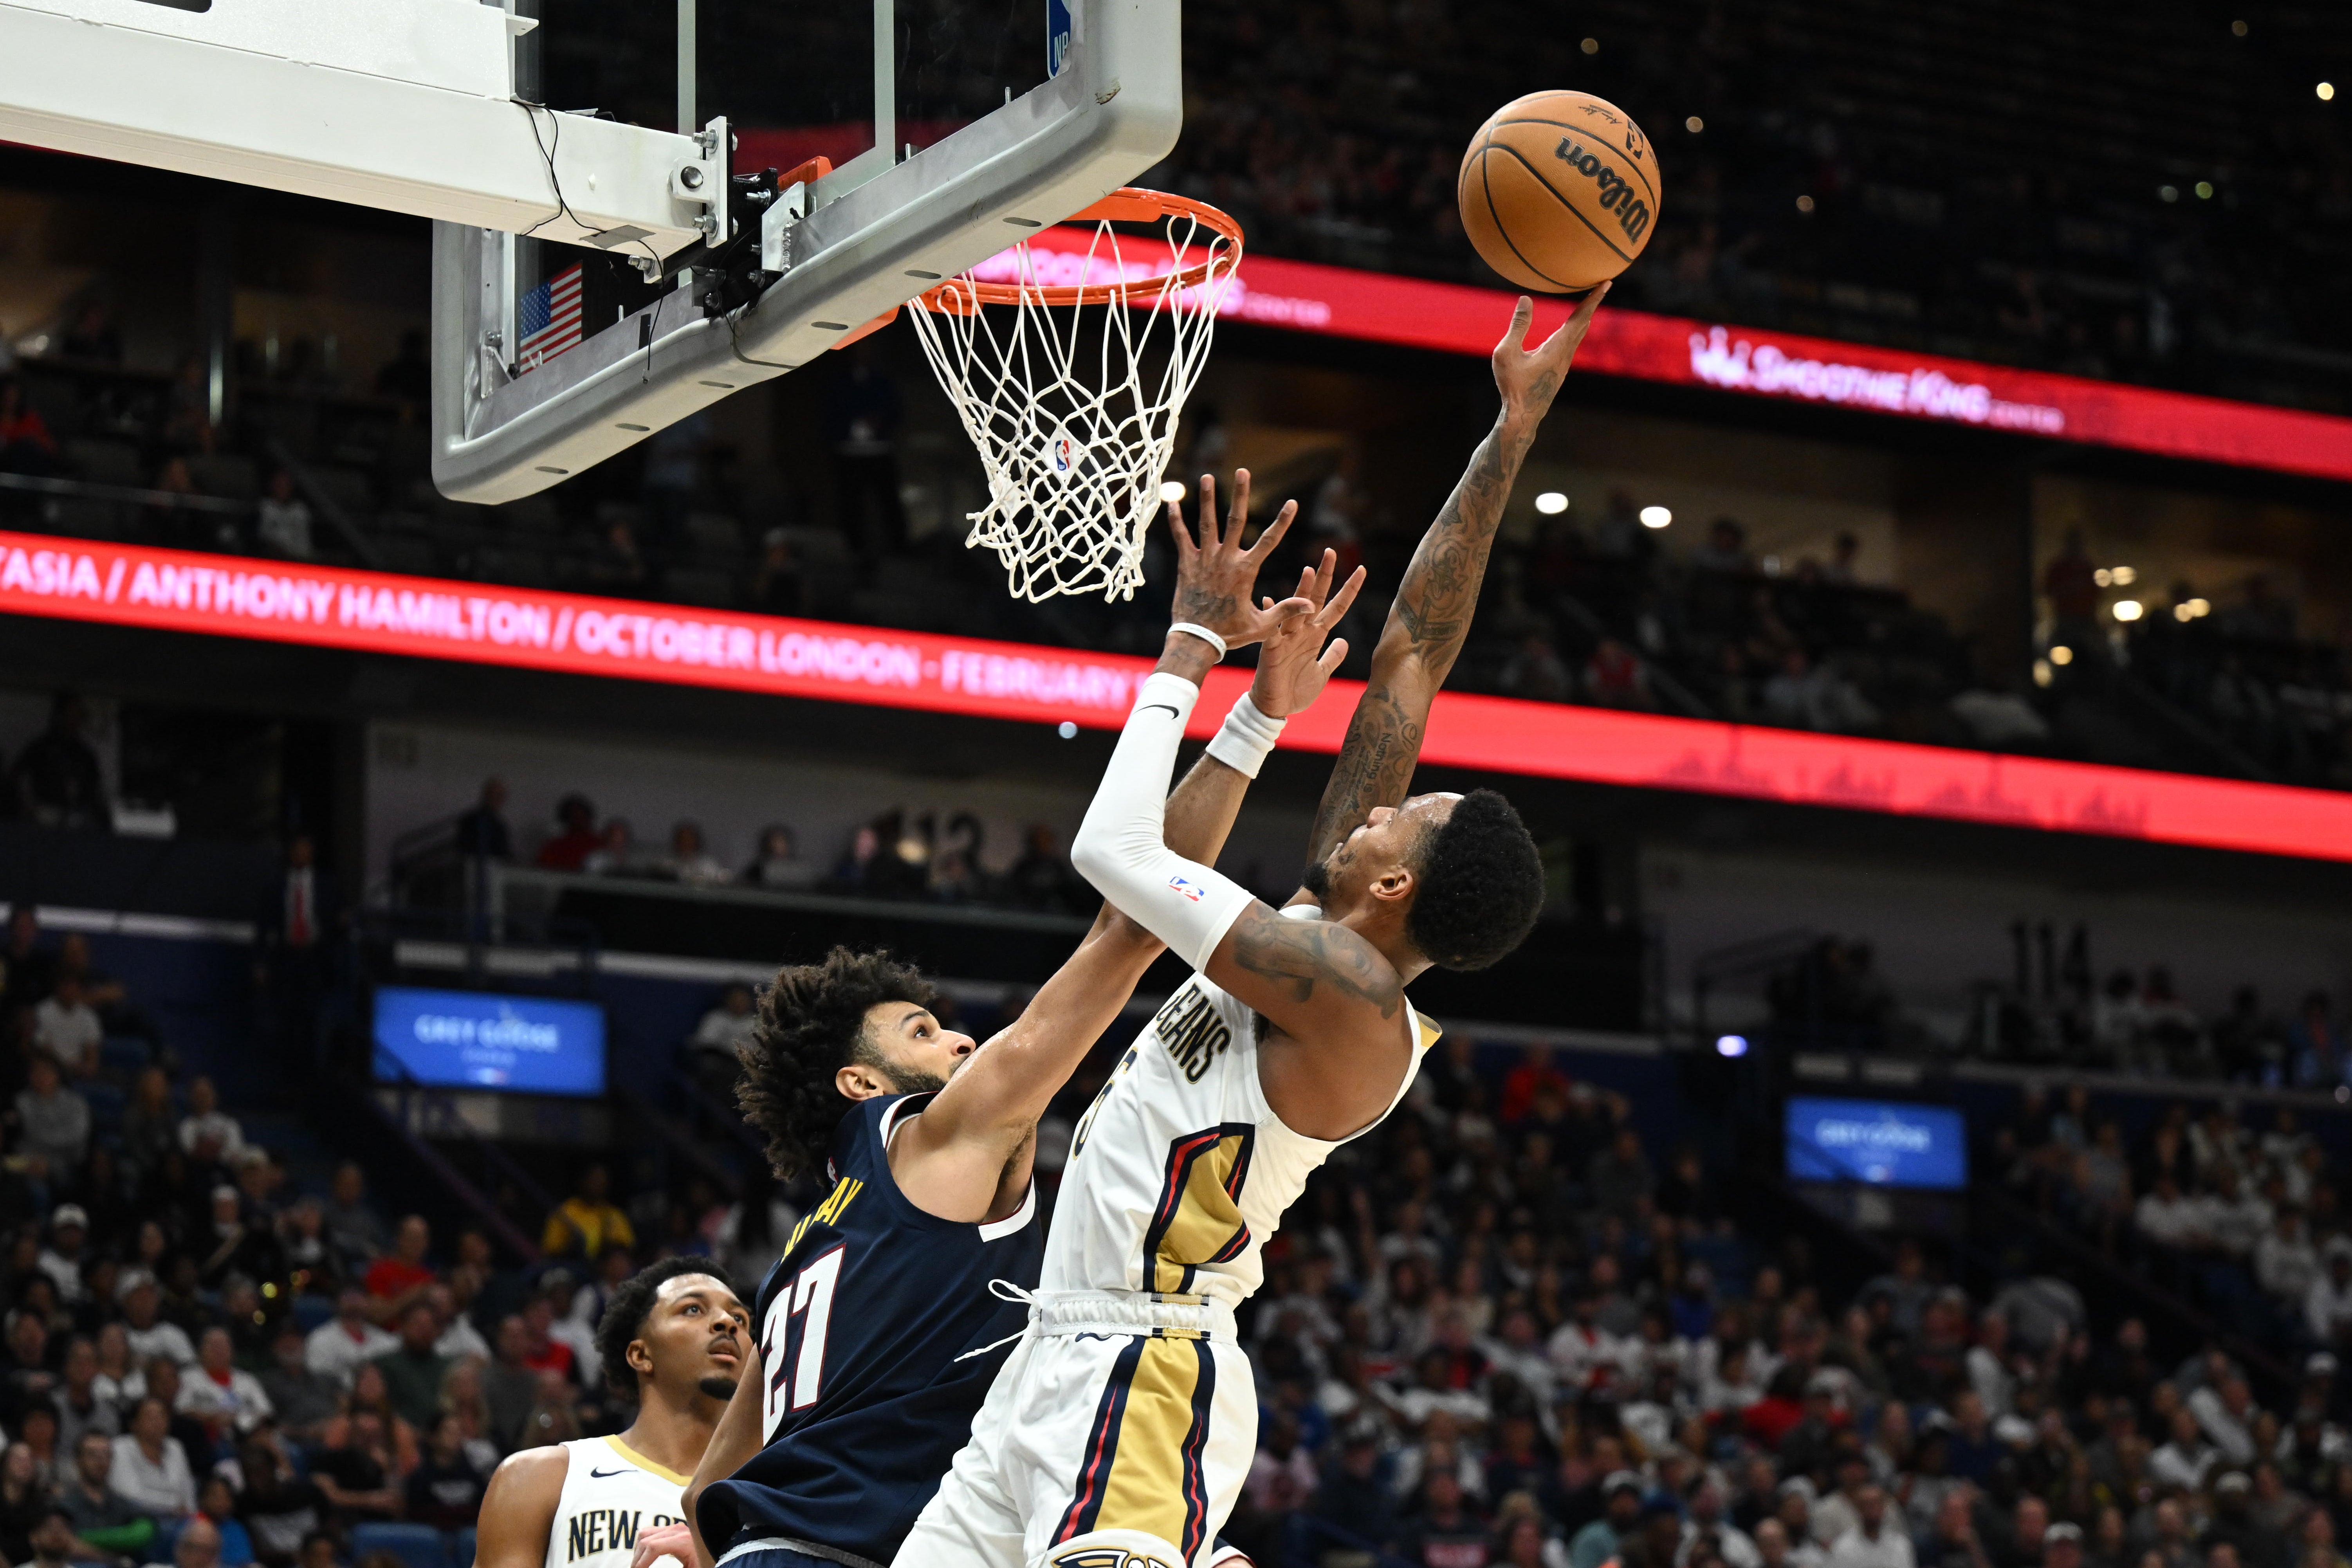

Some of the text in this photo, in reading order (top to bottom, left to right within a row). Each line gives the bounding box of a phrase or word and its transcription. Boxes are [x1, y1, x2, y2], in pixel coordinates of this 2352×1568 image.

[1555, 135, 1650, 246] Wilson
[0, 546, 102, 600] ASIA
[128, 561, 336, 624] ANTHONY
[339, 584, 549, 648] HAMILTON
[574, 610, 756, 670] OCTOBER
[758, 629, 921, 689] LONDON
[941, 650, 1133, 711] FEBRUARY
[759, 1242, 846, 1448] 27
[567, 1509, 642, 1564] NEW
